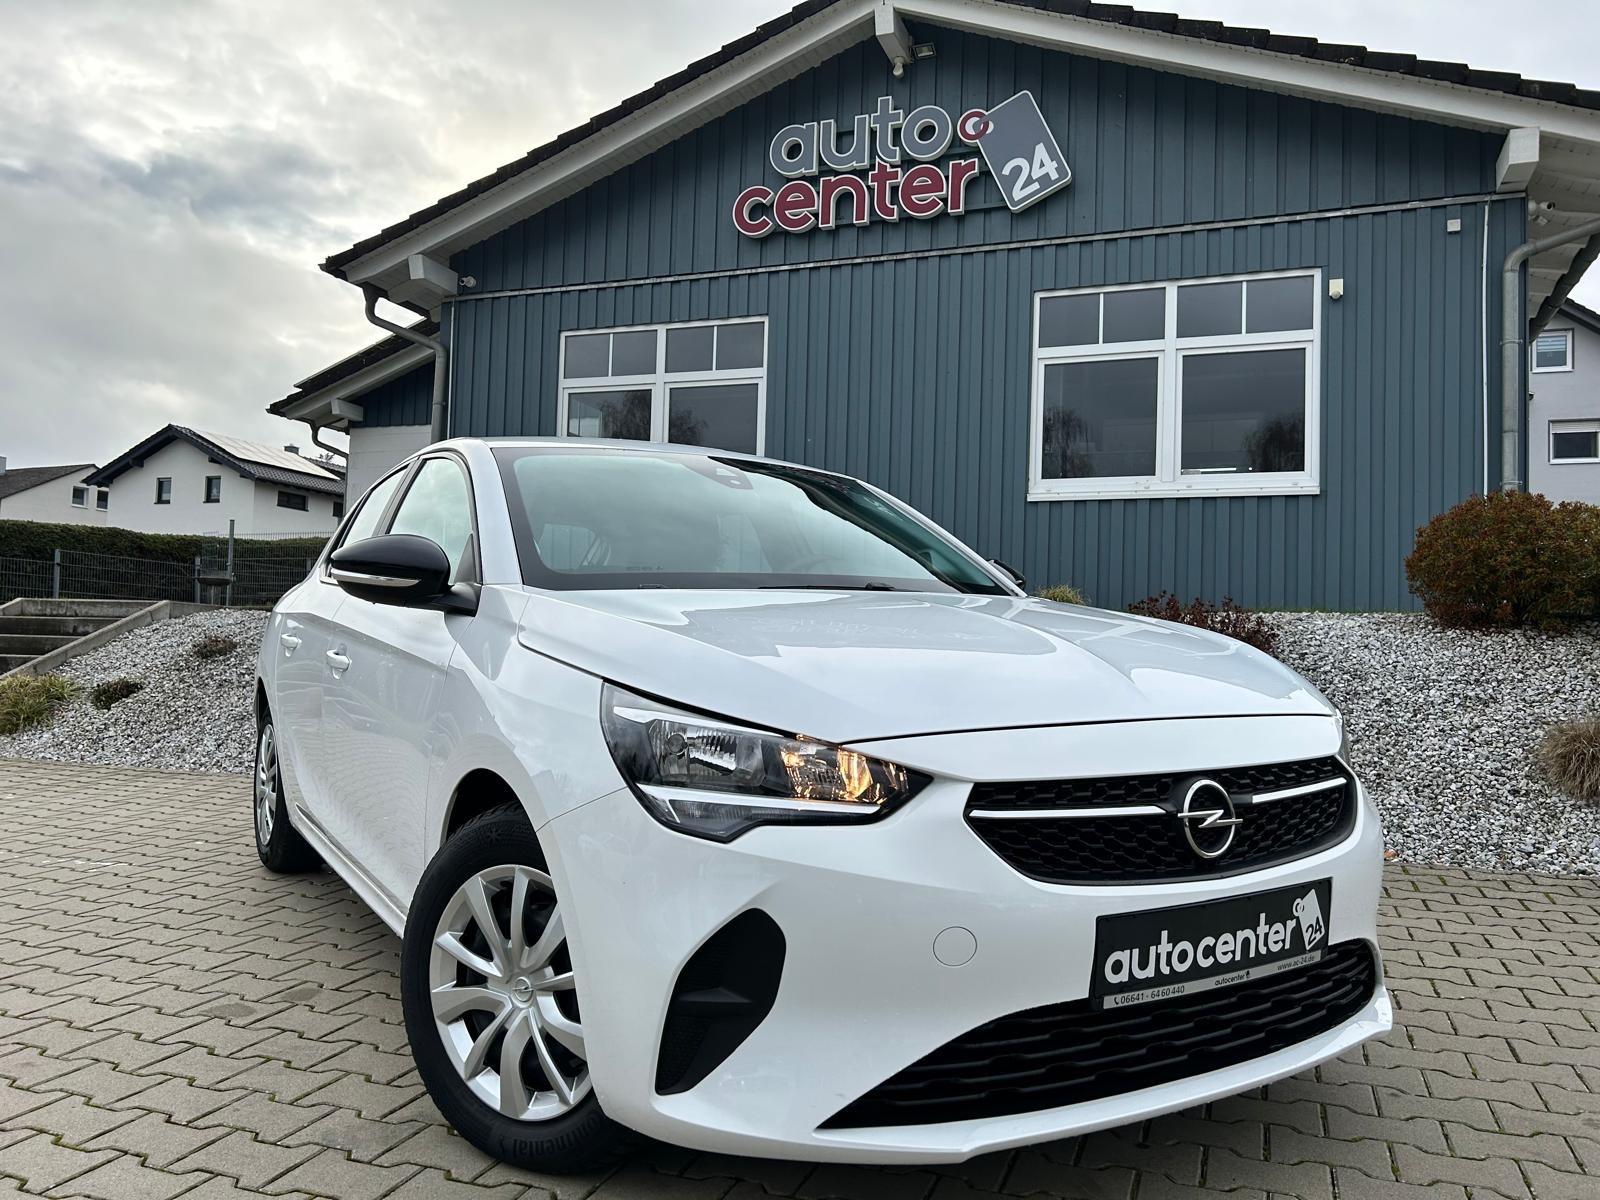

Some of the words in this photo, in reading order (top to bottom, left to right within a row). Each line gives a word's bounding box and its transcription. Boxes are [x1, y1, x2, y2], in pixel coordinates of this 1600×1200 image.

[770, 96, 953, 176] auto
[732, 156, 978, 237] center
[1001, 142, 1058, 201] 24
[1104, 912, 1296, 983] autocenter
[1306, 916, 1322, 946] 24
[1214, 973, 1245, 986] autocenter
[1120, 992, 1144, 1005] 06641
